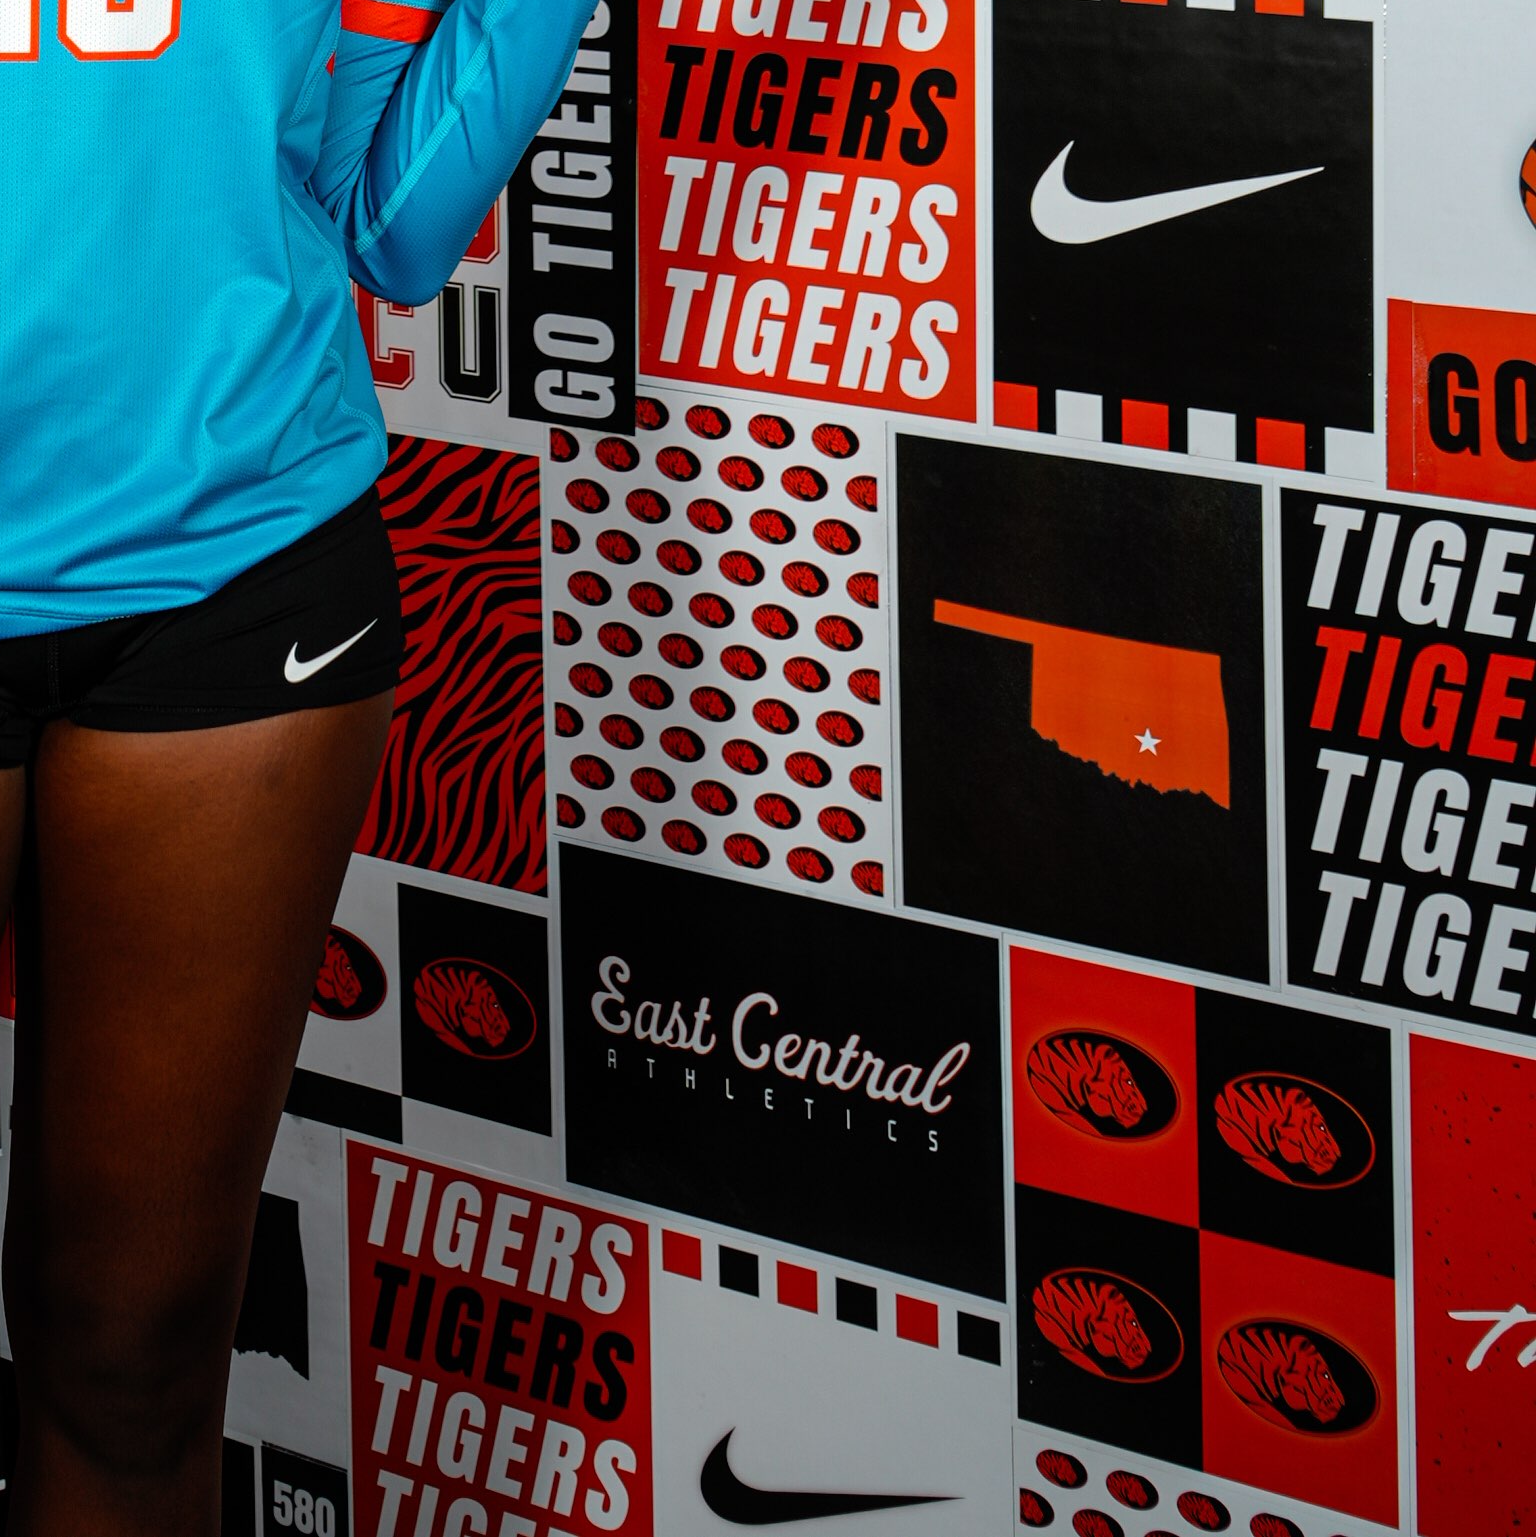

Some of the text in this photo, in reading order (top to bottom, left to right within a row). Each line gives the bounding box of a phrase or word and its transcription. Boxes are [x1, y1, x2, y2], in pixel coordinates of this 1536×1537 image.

[658, 43, 958, 168] TIGERS
[658, 154, 959, 284] TIGERS
[352, 281, 501, 404] CU
[533, 312, 616, 421] GO
[659, 265, 959, 401] TIGERS
[1427, 352, 1536, 463] GO
[1307, 503, 1536, 642] TIGE
[1309, 625, 1536, 768] TIGE
[1311, 748, 1536, 892] TIGE
[1313, 870, 1536, 1018] TIGE
[591, 955, 971, 1114] East Central
[608, 1048, 938, 1153] ATHLETICS
[367, 1156, 633, 1315] TIGERS
[369, 1260, 635, 1422] TIGERS
[273, 1479, 335, 1537] 580
[371, 1364, 637, 1531] TIGERS
